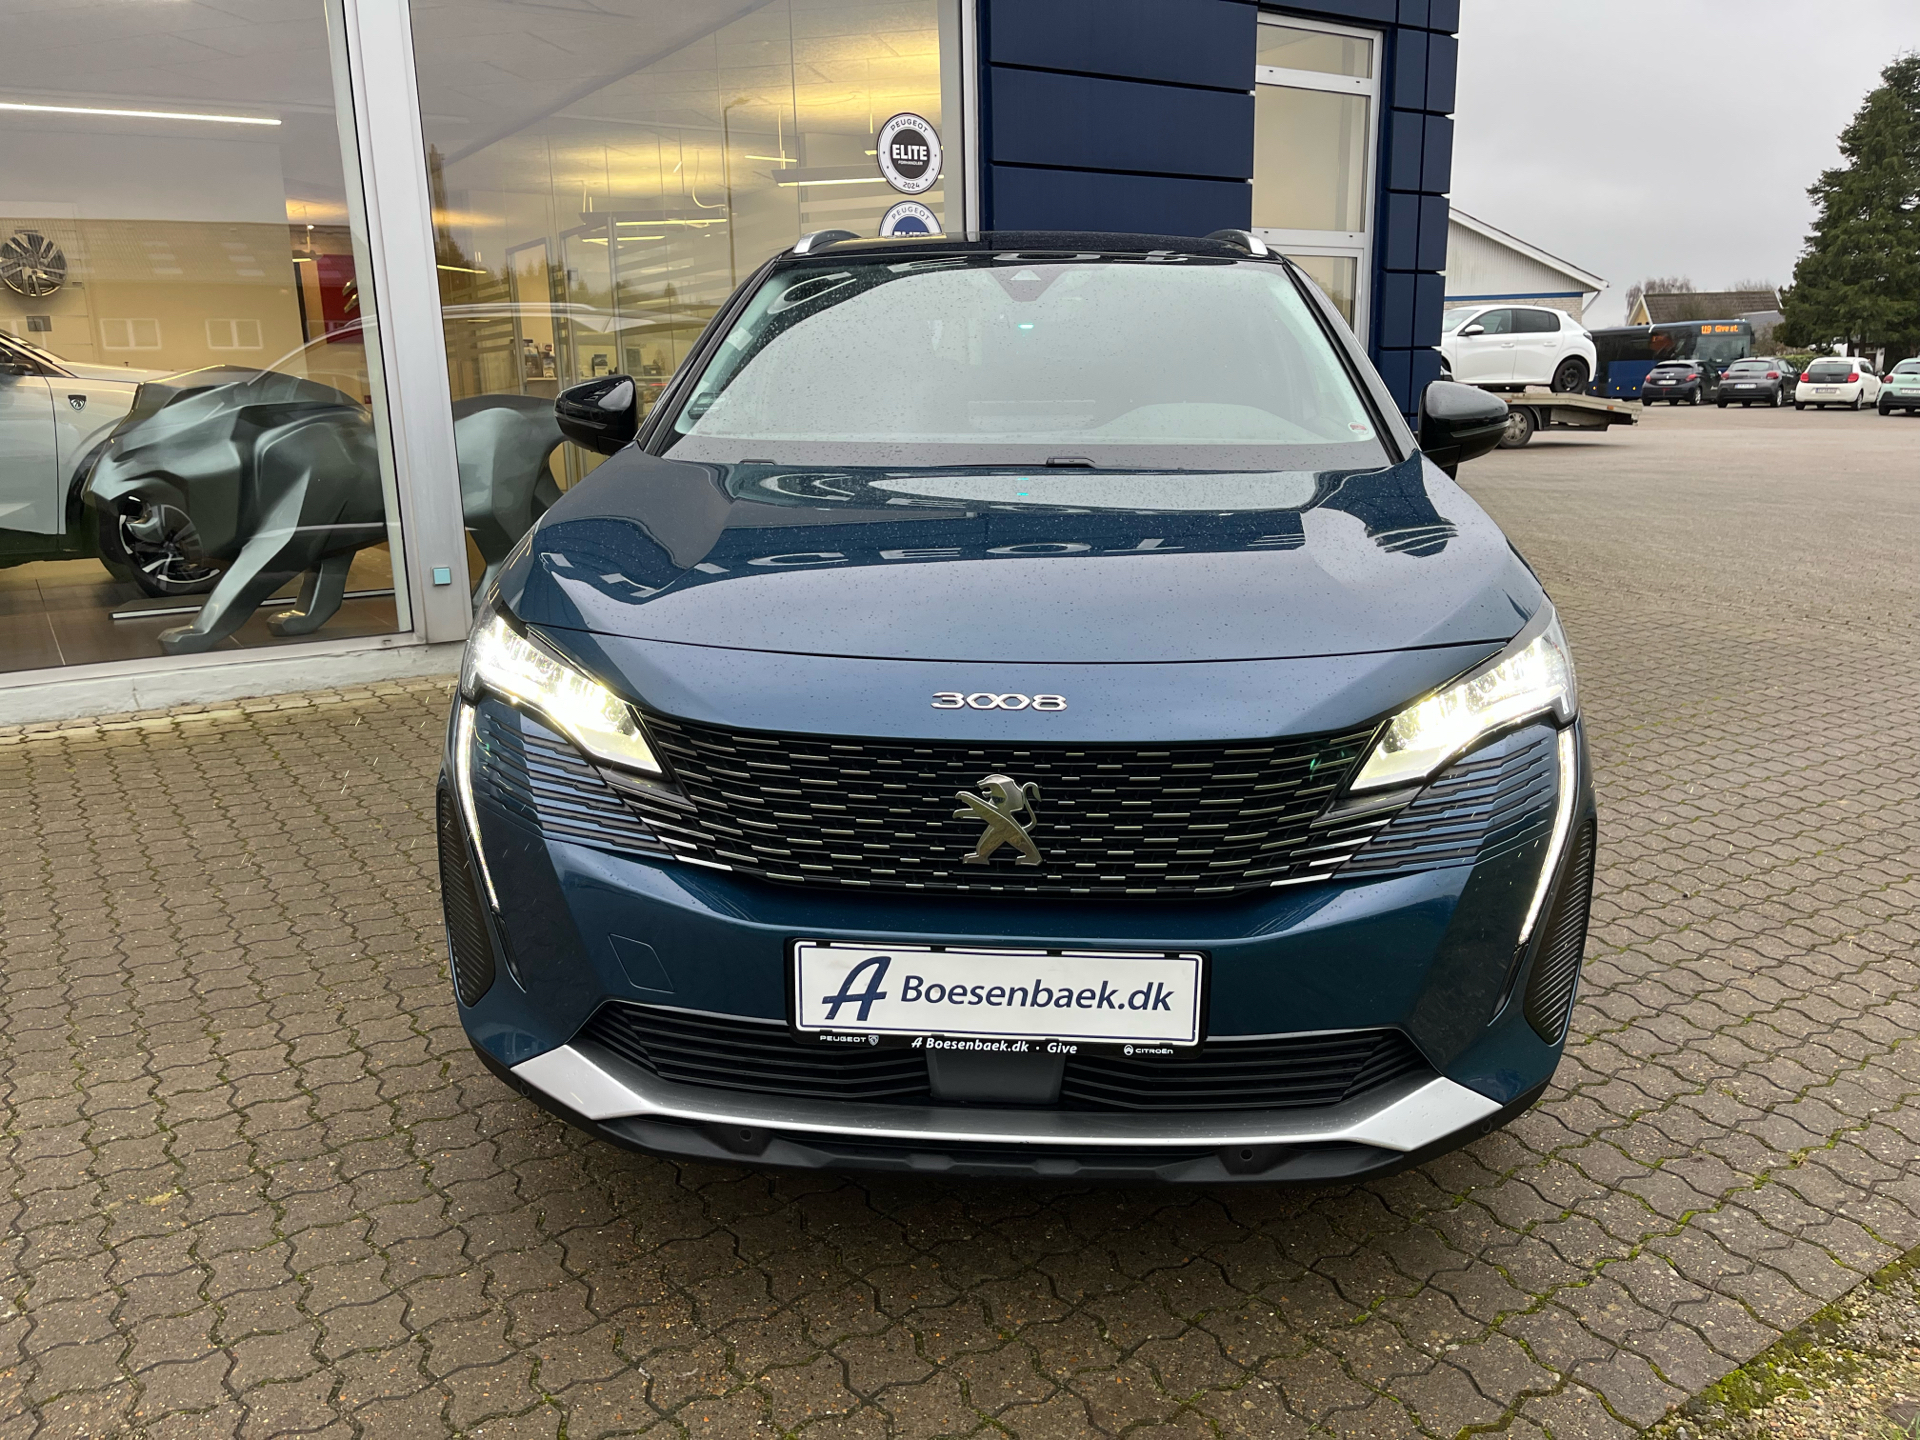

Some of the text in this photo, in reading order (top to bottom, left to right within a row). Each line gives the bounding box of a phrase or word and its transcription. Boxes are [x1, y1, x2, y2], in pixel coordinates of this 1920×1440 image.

[890, 118, 929, 134] PEUGEOT
[892, 144, 928, 161] ELITE
[902, 181, 920, 190] 2024
[891, 206, 931, 221] PEUGEOT
[930, 691, 1068, 711] 3008
[900, 974, 1175, 1012] Boesenbaek.dk
[819, 1035, 867, 1043] PEUGEOT
[926, 1037, 1029, 1052] Boesenbaek.dk
[1047, 1042, 1078, 1054] Give
